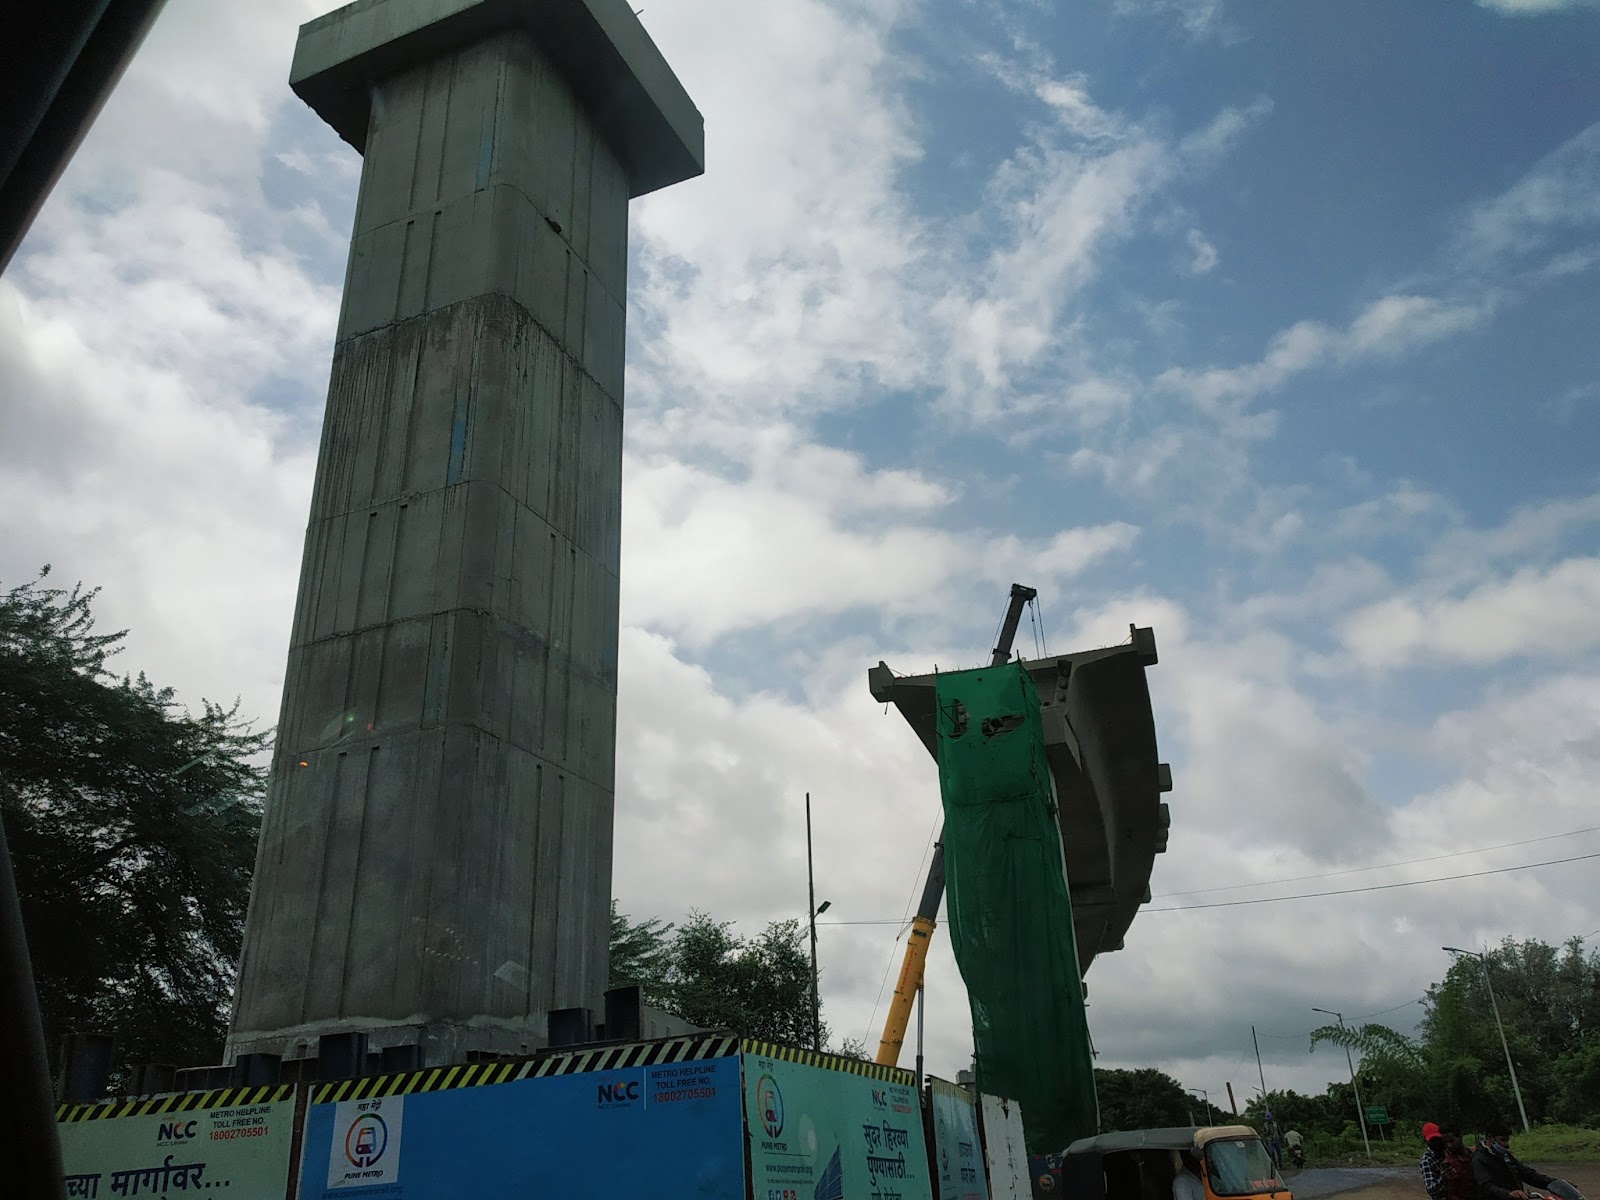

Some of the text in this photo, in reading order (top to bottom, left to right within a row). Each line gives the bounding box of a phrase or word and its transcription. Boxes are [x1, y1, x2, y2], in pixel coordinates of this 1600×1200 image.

[651, 1065, 716, 1079] METRO HELPLINE
[656, 1076, 712, 1090] TOLL FREE NO.
[598, 1081, 639, 1103] NCC
[653, 1087, 716, 1103] 18002705501
[209, 1106, 271, 1119] METRO HELPLINE
[213, 1116, 265, 1129] TOLL FREE NO.
[157, 1120, 198, 1141] NCC
[208, 1126, 269, 1141] 18002705501
[863, 1118, 881, 1154] सुंदर
[344, 1169, 384, 1180] PUNE METRO
